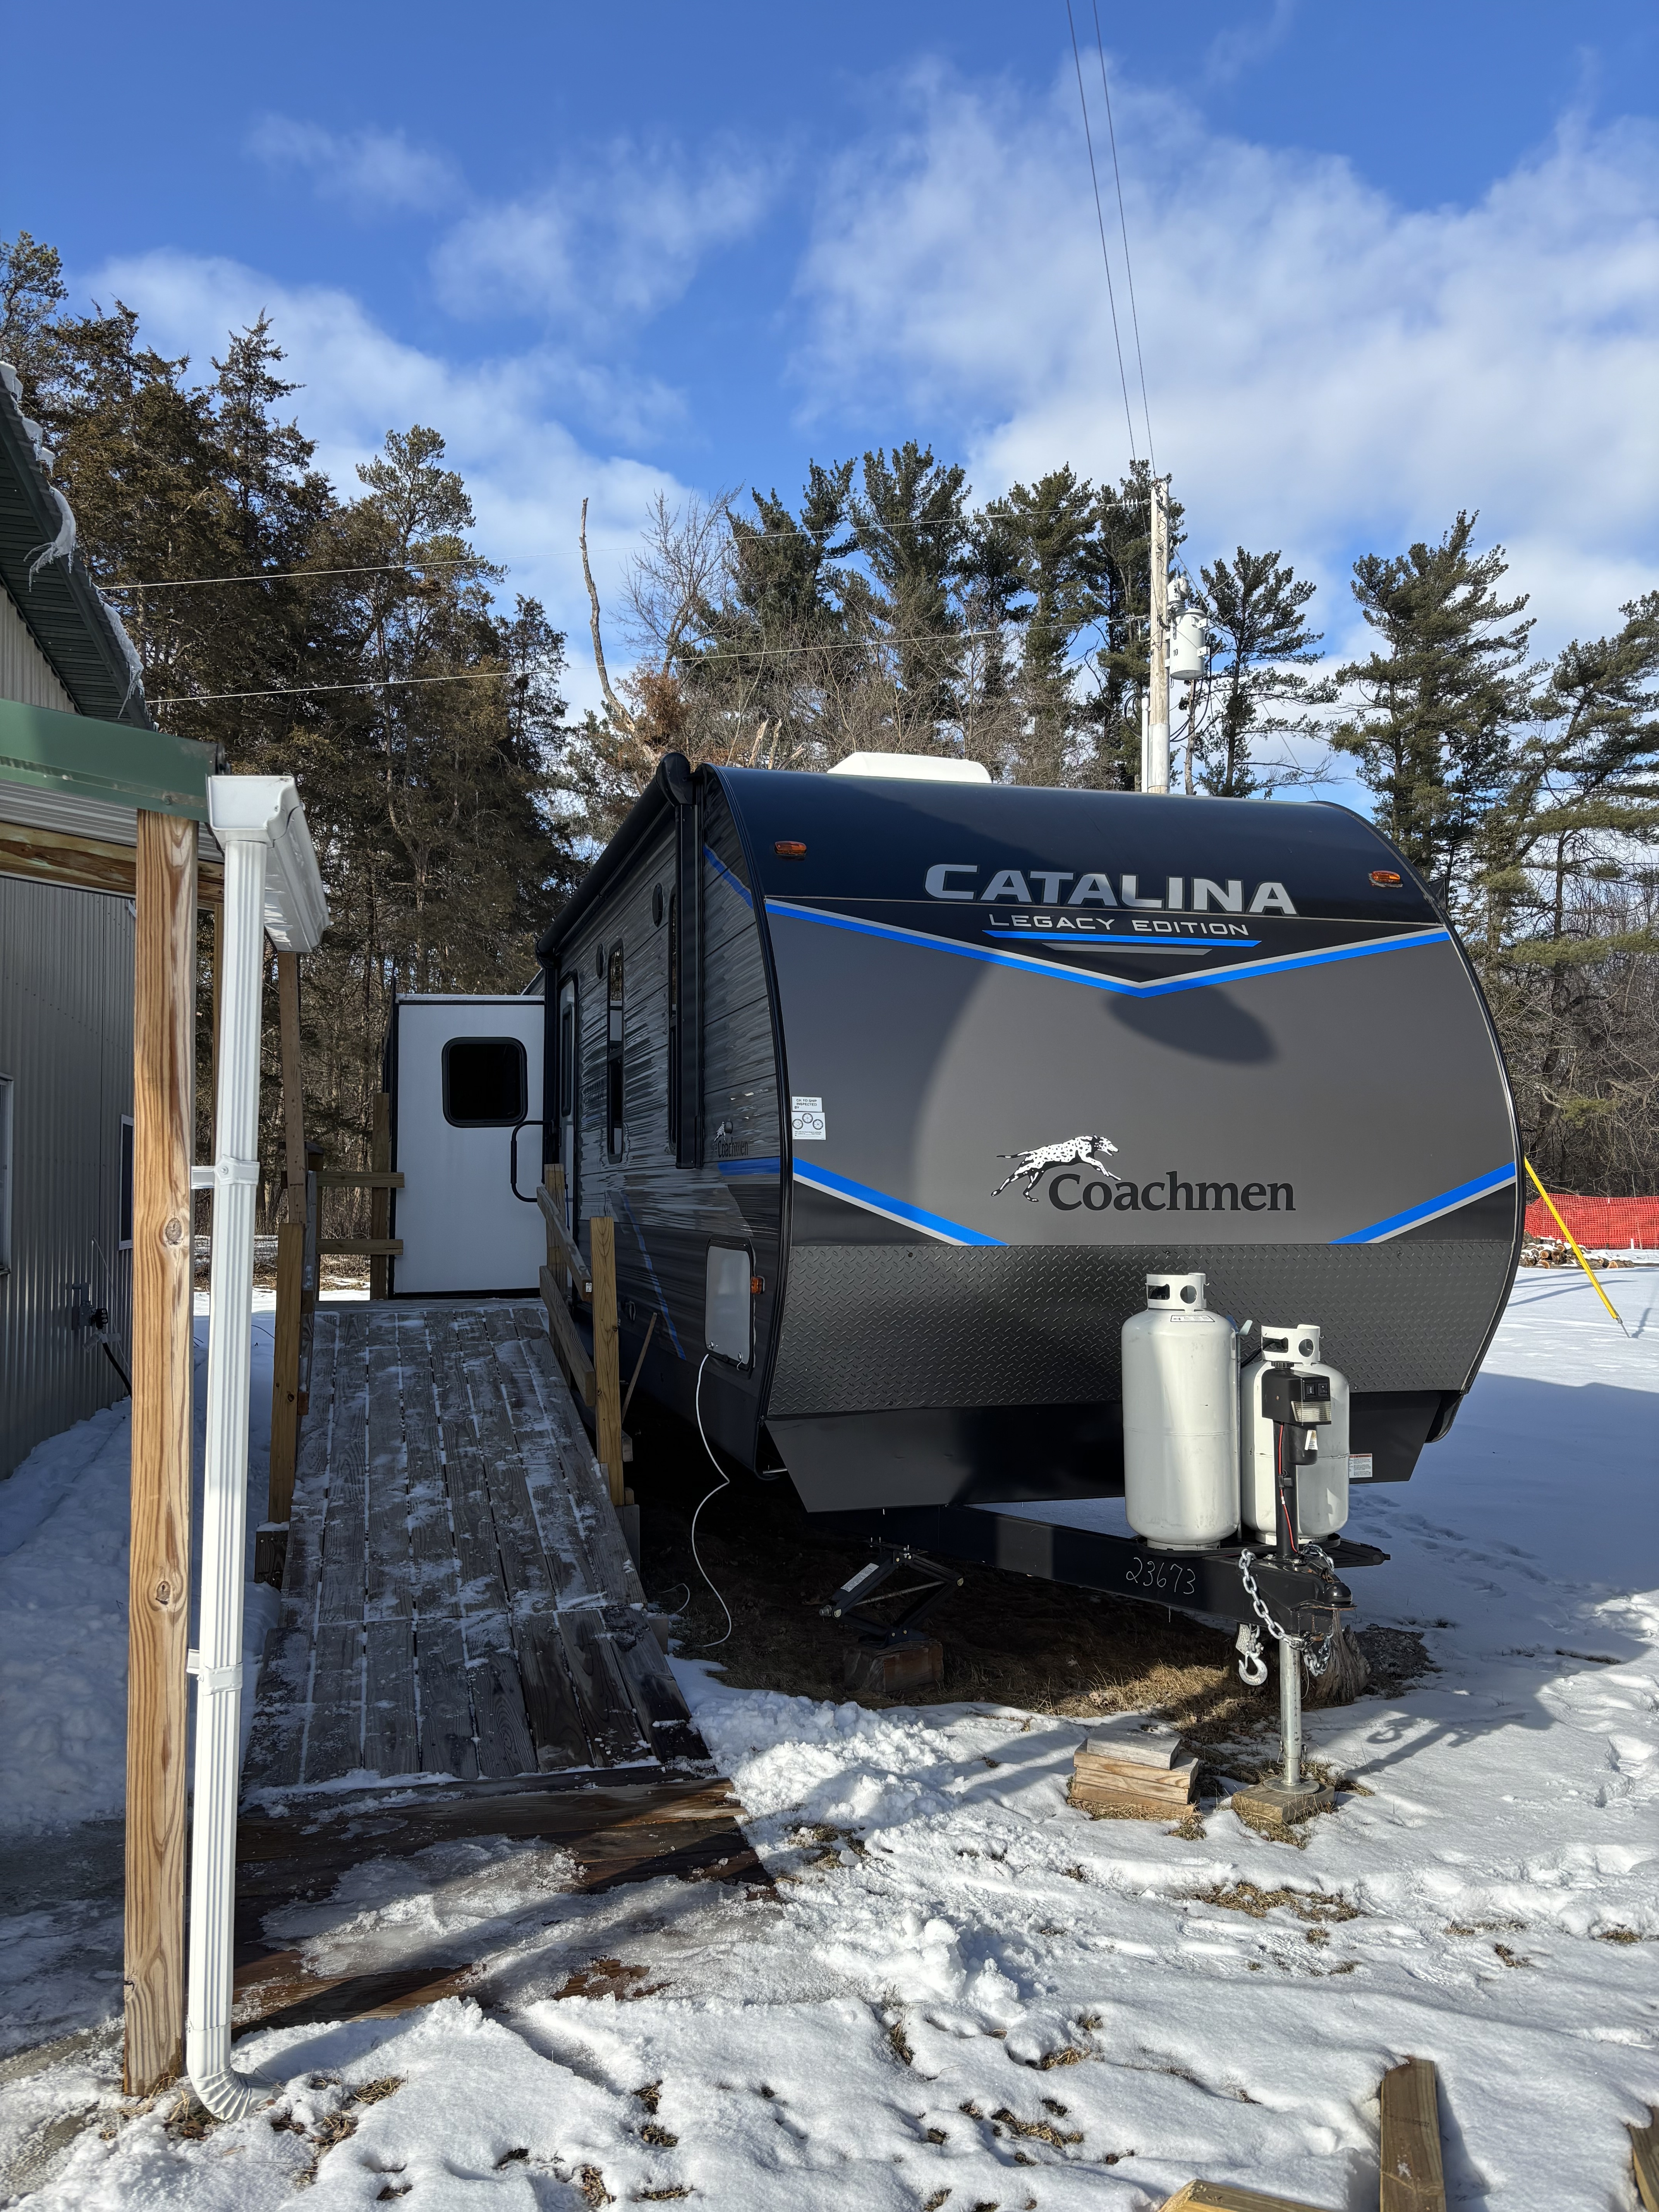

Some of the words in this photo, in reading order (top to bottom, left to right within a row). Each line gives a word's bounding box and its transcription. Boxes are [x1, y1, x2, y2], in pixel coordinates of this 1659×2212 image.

[925, 864, 1298, 915] CATALINA
[990, 914, 1115, 930] LEGACY
[1132, 920, 1249, 936] EDITION
[718, 1137, 748, 1158] Coachmen
[1049, 1171, 1296, 1211] Coachmen
[1126, 1557, 1195, 1594] 23673
